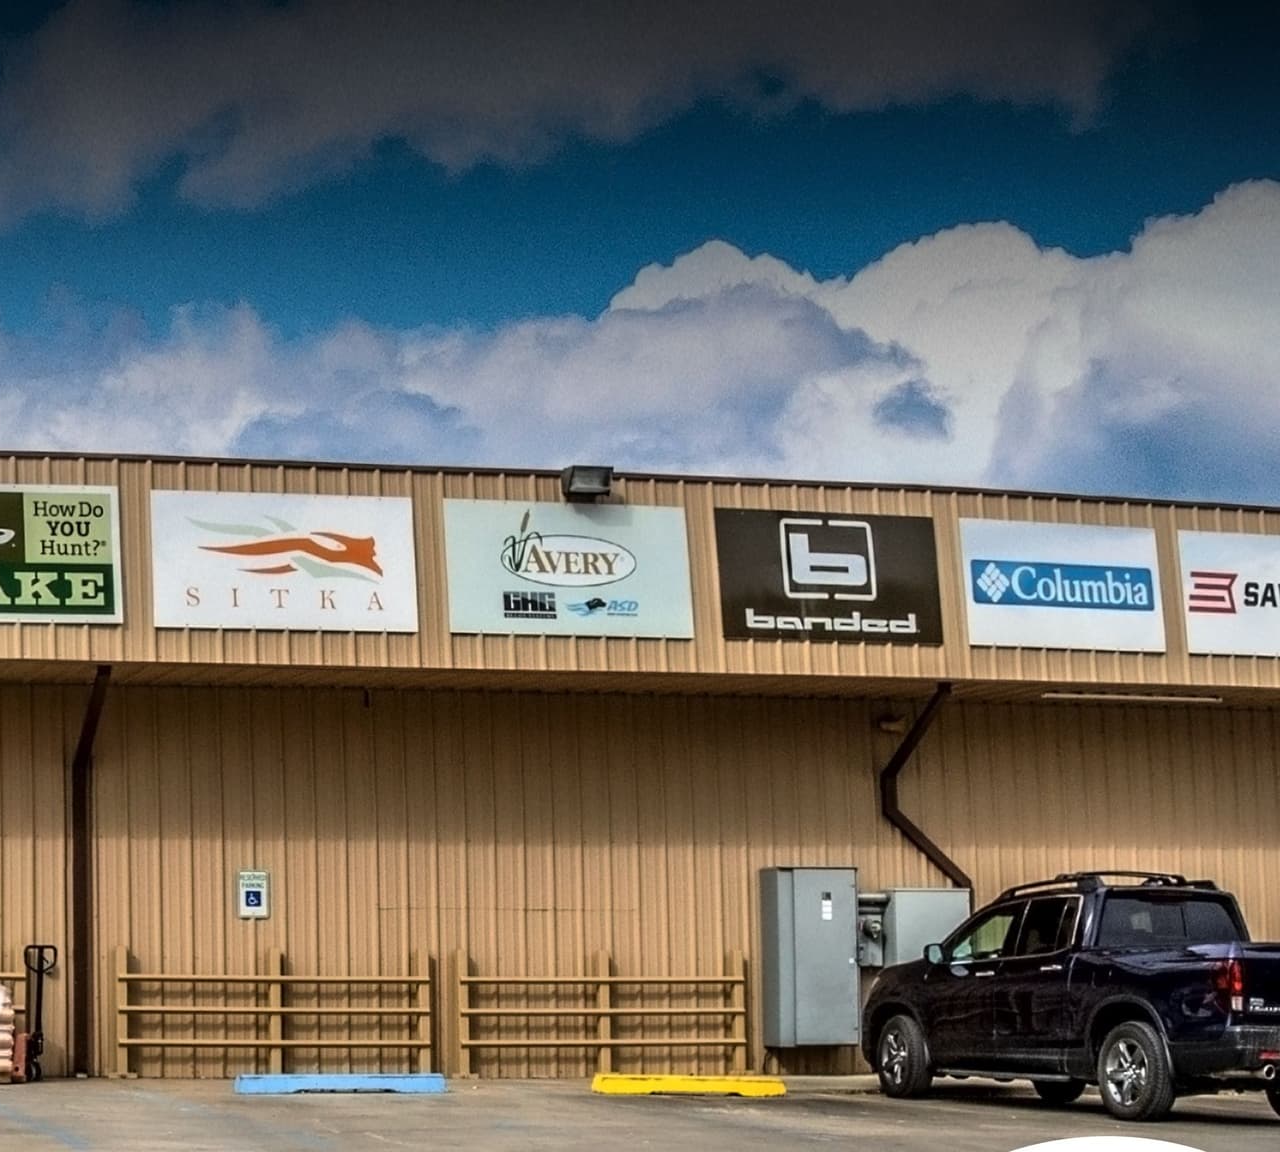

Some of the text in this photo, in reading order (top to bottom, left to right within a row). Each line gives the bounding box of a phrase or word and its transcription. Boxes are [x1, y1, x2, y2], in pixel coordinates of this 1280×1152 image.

[32, 500, 104, 518] How Do
[47, 520, 92, 537] YOU
[523, 543, 620, 576] AVERY
[1010, 565, 1150, 606] Columbia
[185, 587, 384, 612] SITKA
[745, 607, 917, 634] banded
